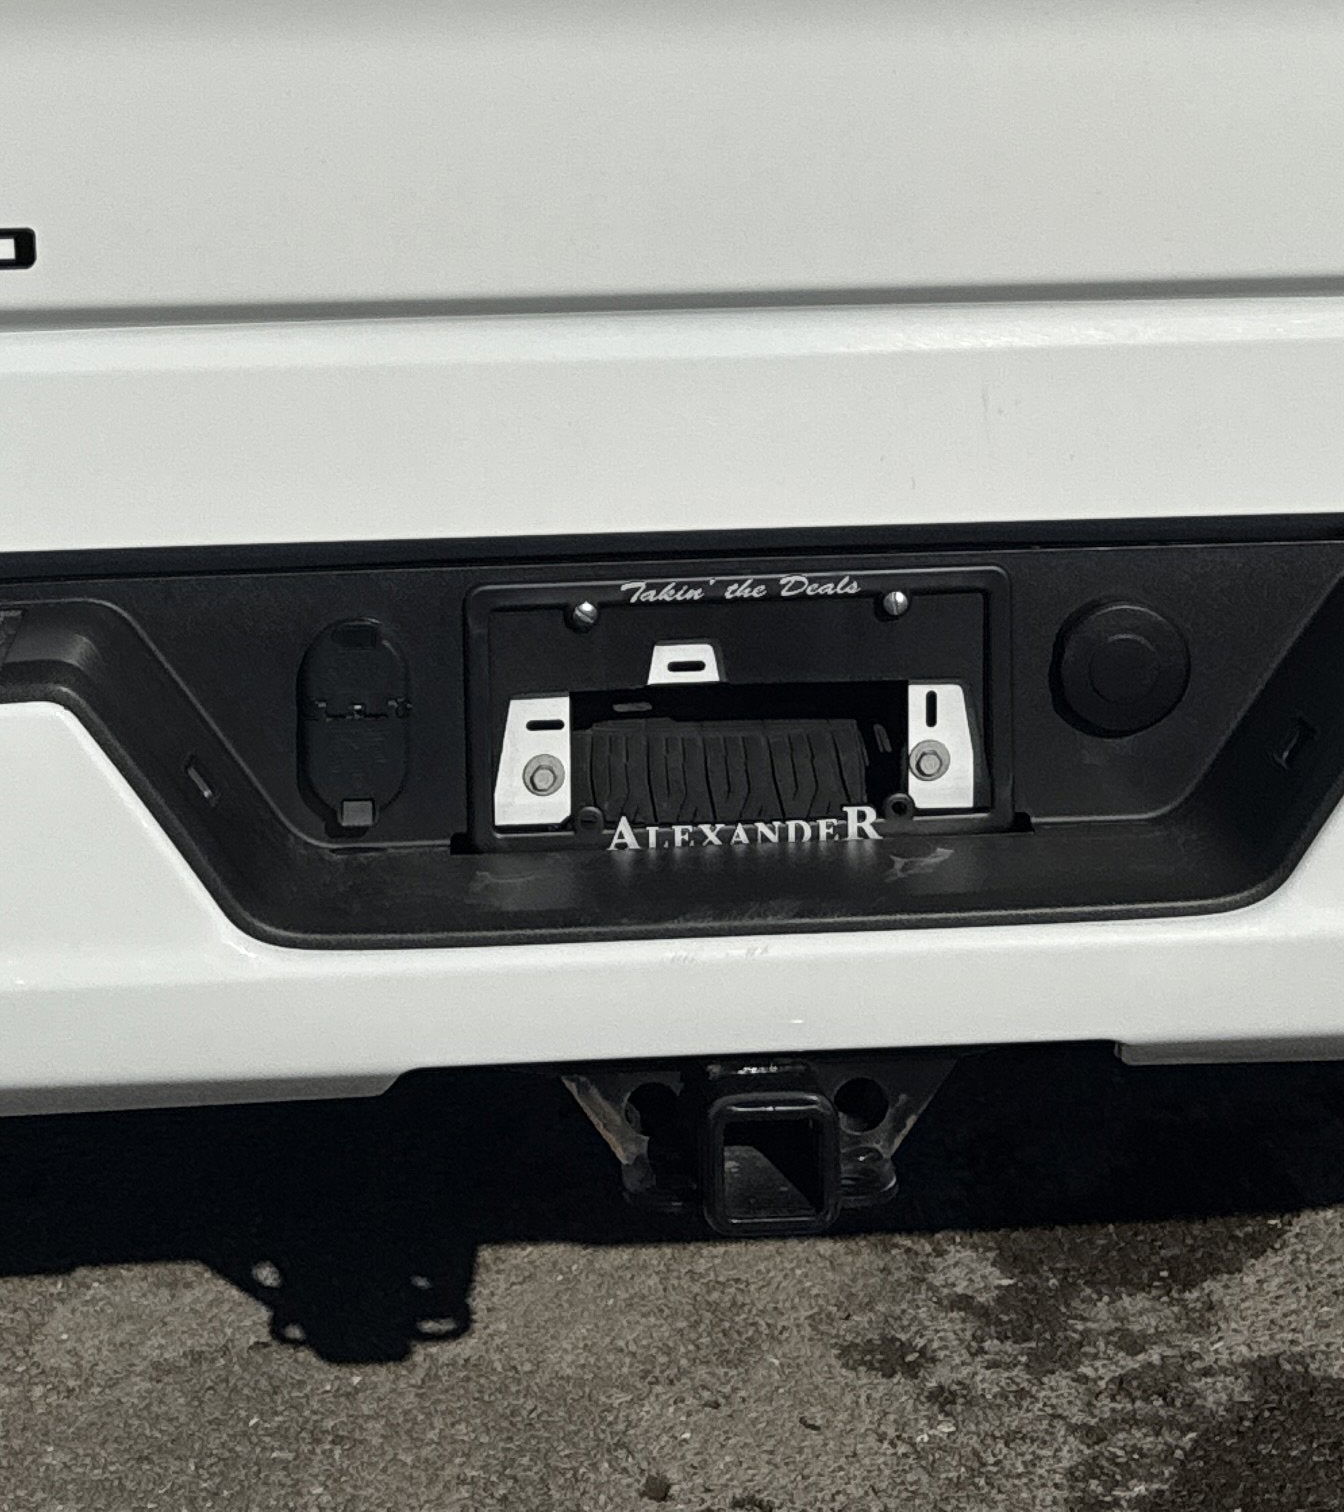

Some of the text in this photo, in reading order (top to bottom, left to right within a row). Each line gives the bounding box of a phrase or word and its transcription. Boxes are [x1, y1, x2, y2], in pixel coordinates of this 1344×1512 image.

[620, 575, 861, 603] Takin' the Deals
[607, 805, 884, 851] ALEXANDER
